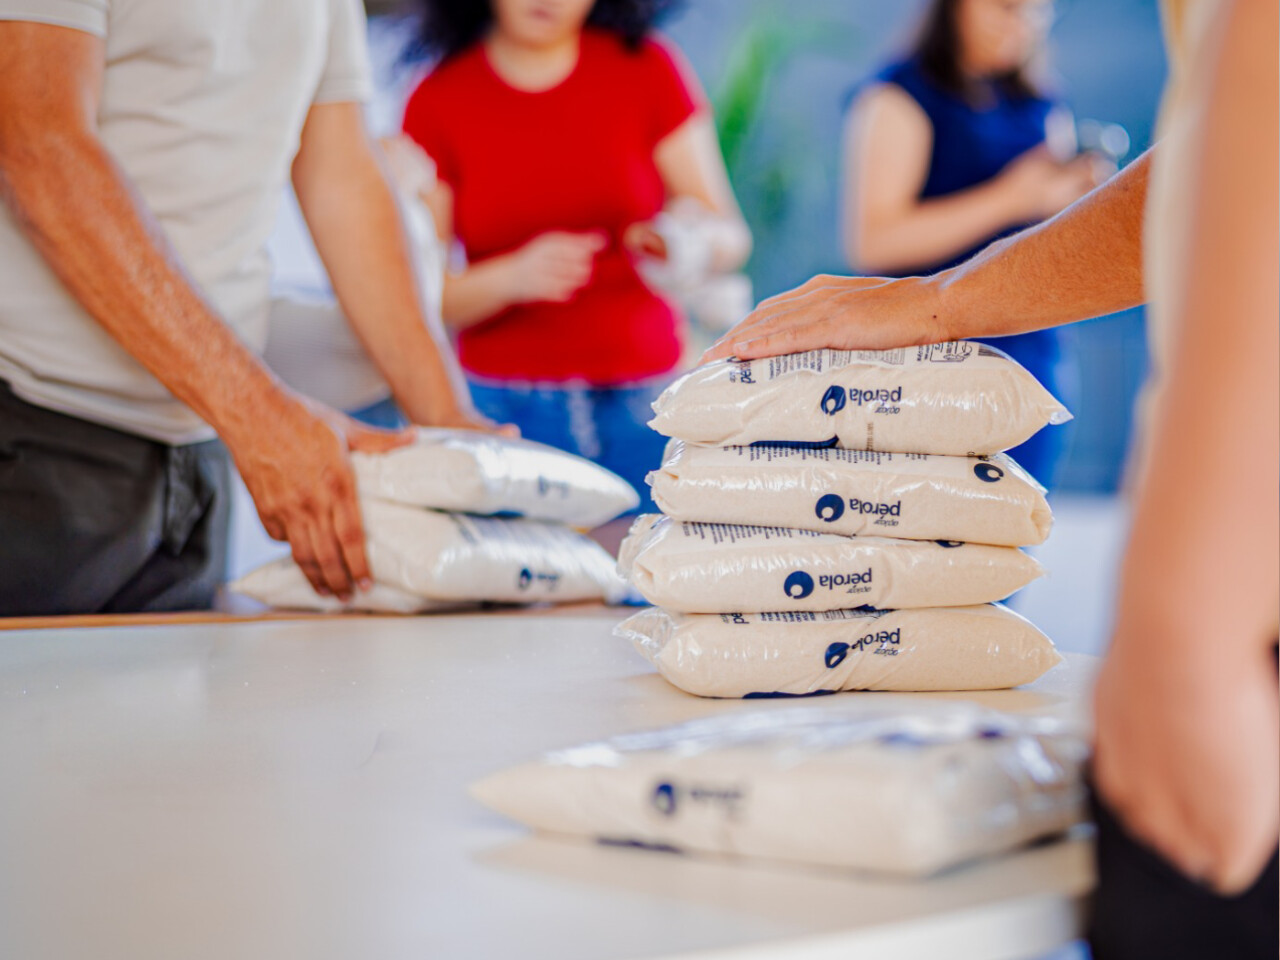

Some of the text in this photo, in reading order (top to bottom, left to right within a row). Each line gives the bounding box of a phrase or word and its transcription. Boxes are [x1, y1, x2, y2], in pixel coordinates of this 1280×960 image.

[849, 386, 901, 406] pérola
[849, 498, 900, 517] pérola
[819, 567, 871, 590] pérola
